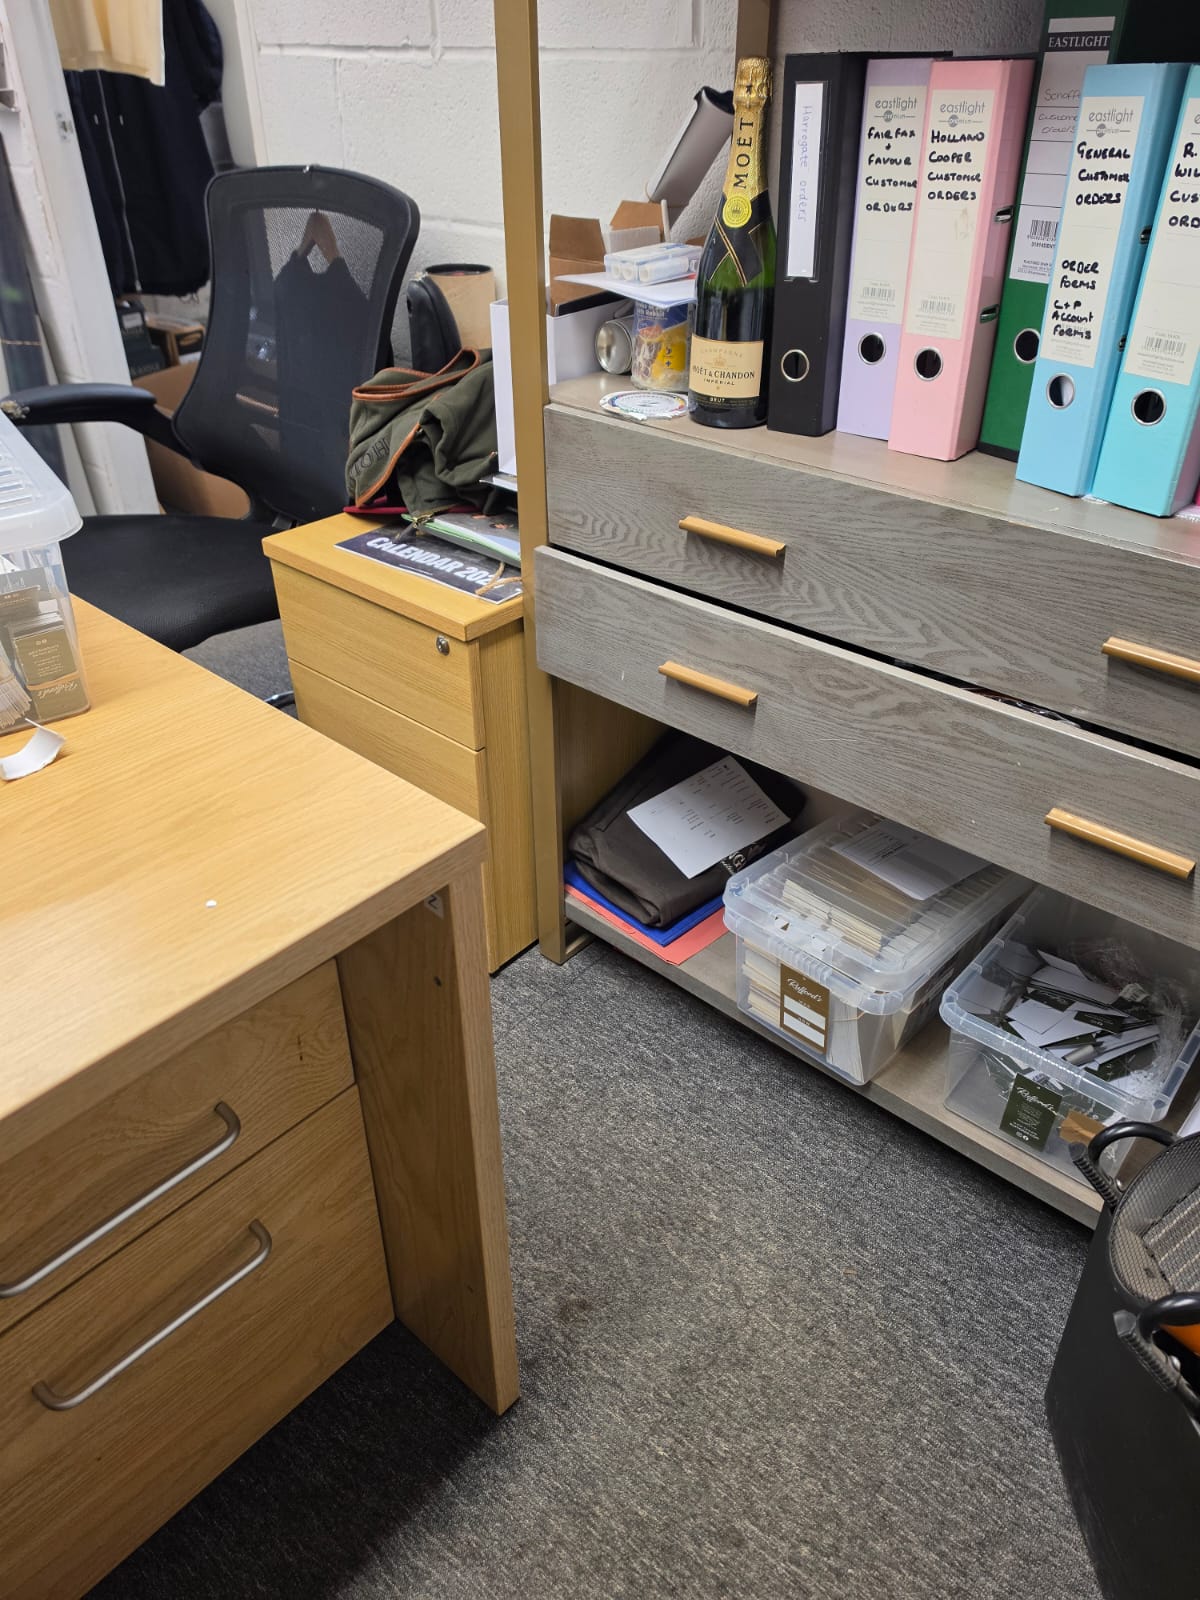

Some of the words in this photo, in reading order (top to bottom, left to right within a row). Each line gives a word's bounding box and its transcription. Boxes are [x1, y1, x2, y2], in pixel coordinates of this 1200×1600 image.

[1048, 35, 1111, 48] EASTLIGHT
[874, 96, 918, 111] eastlight
[940, 101, 985, 115] eastlight
[1088, 107, 1133, 125] eastlight
[931, 129, 985, 143] HOLLAND
[928, 151, 972, 164] COOPER
[1077, 141, 1131, 160] GENERAL
[868, 153, 912, 166] FAVOUR
[1078, 168, 1130, 183] CUSTOMER
[927, 190, 977, 201] ORDERS
[1075, 192, 1122, 206] ORDERS
[1170, 190, 1200, 204] CUS
[865, 202, 913, 212] ORDERS
[1061, 259, 1100, 274] ORDER
[714, 370, 755, 380] CHANDON
[366, 537, 464, 573] CALENDAR
[454, 566, 504, 589] 202
